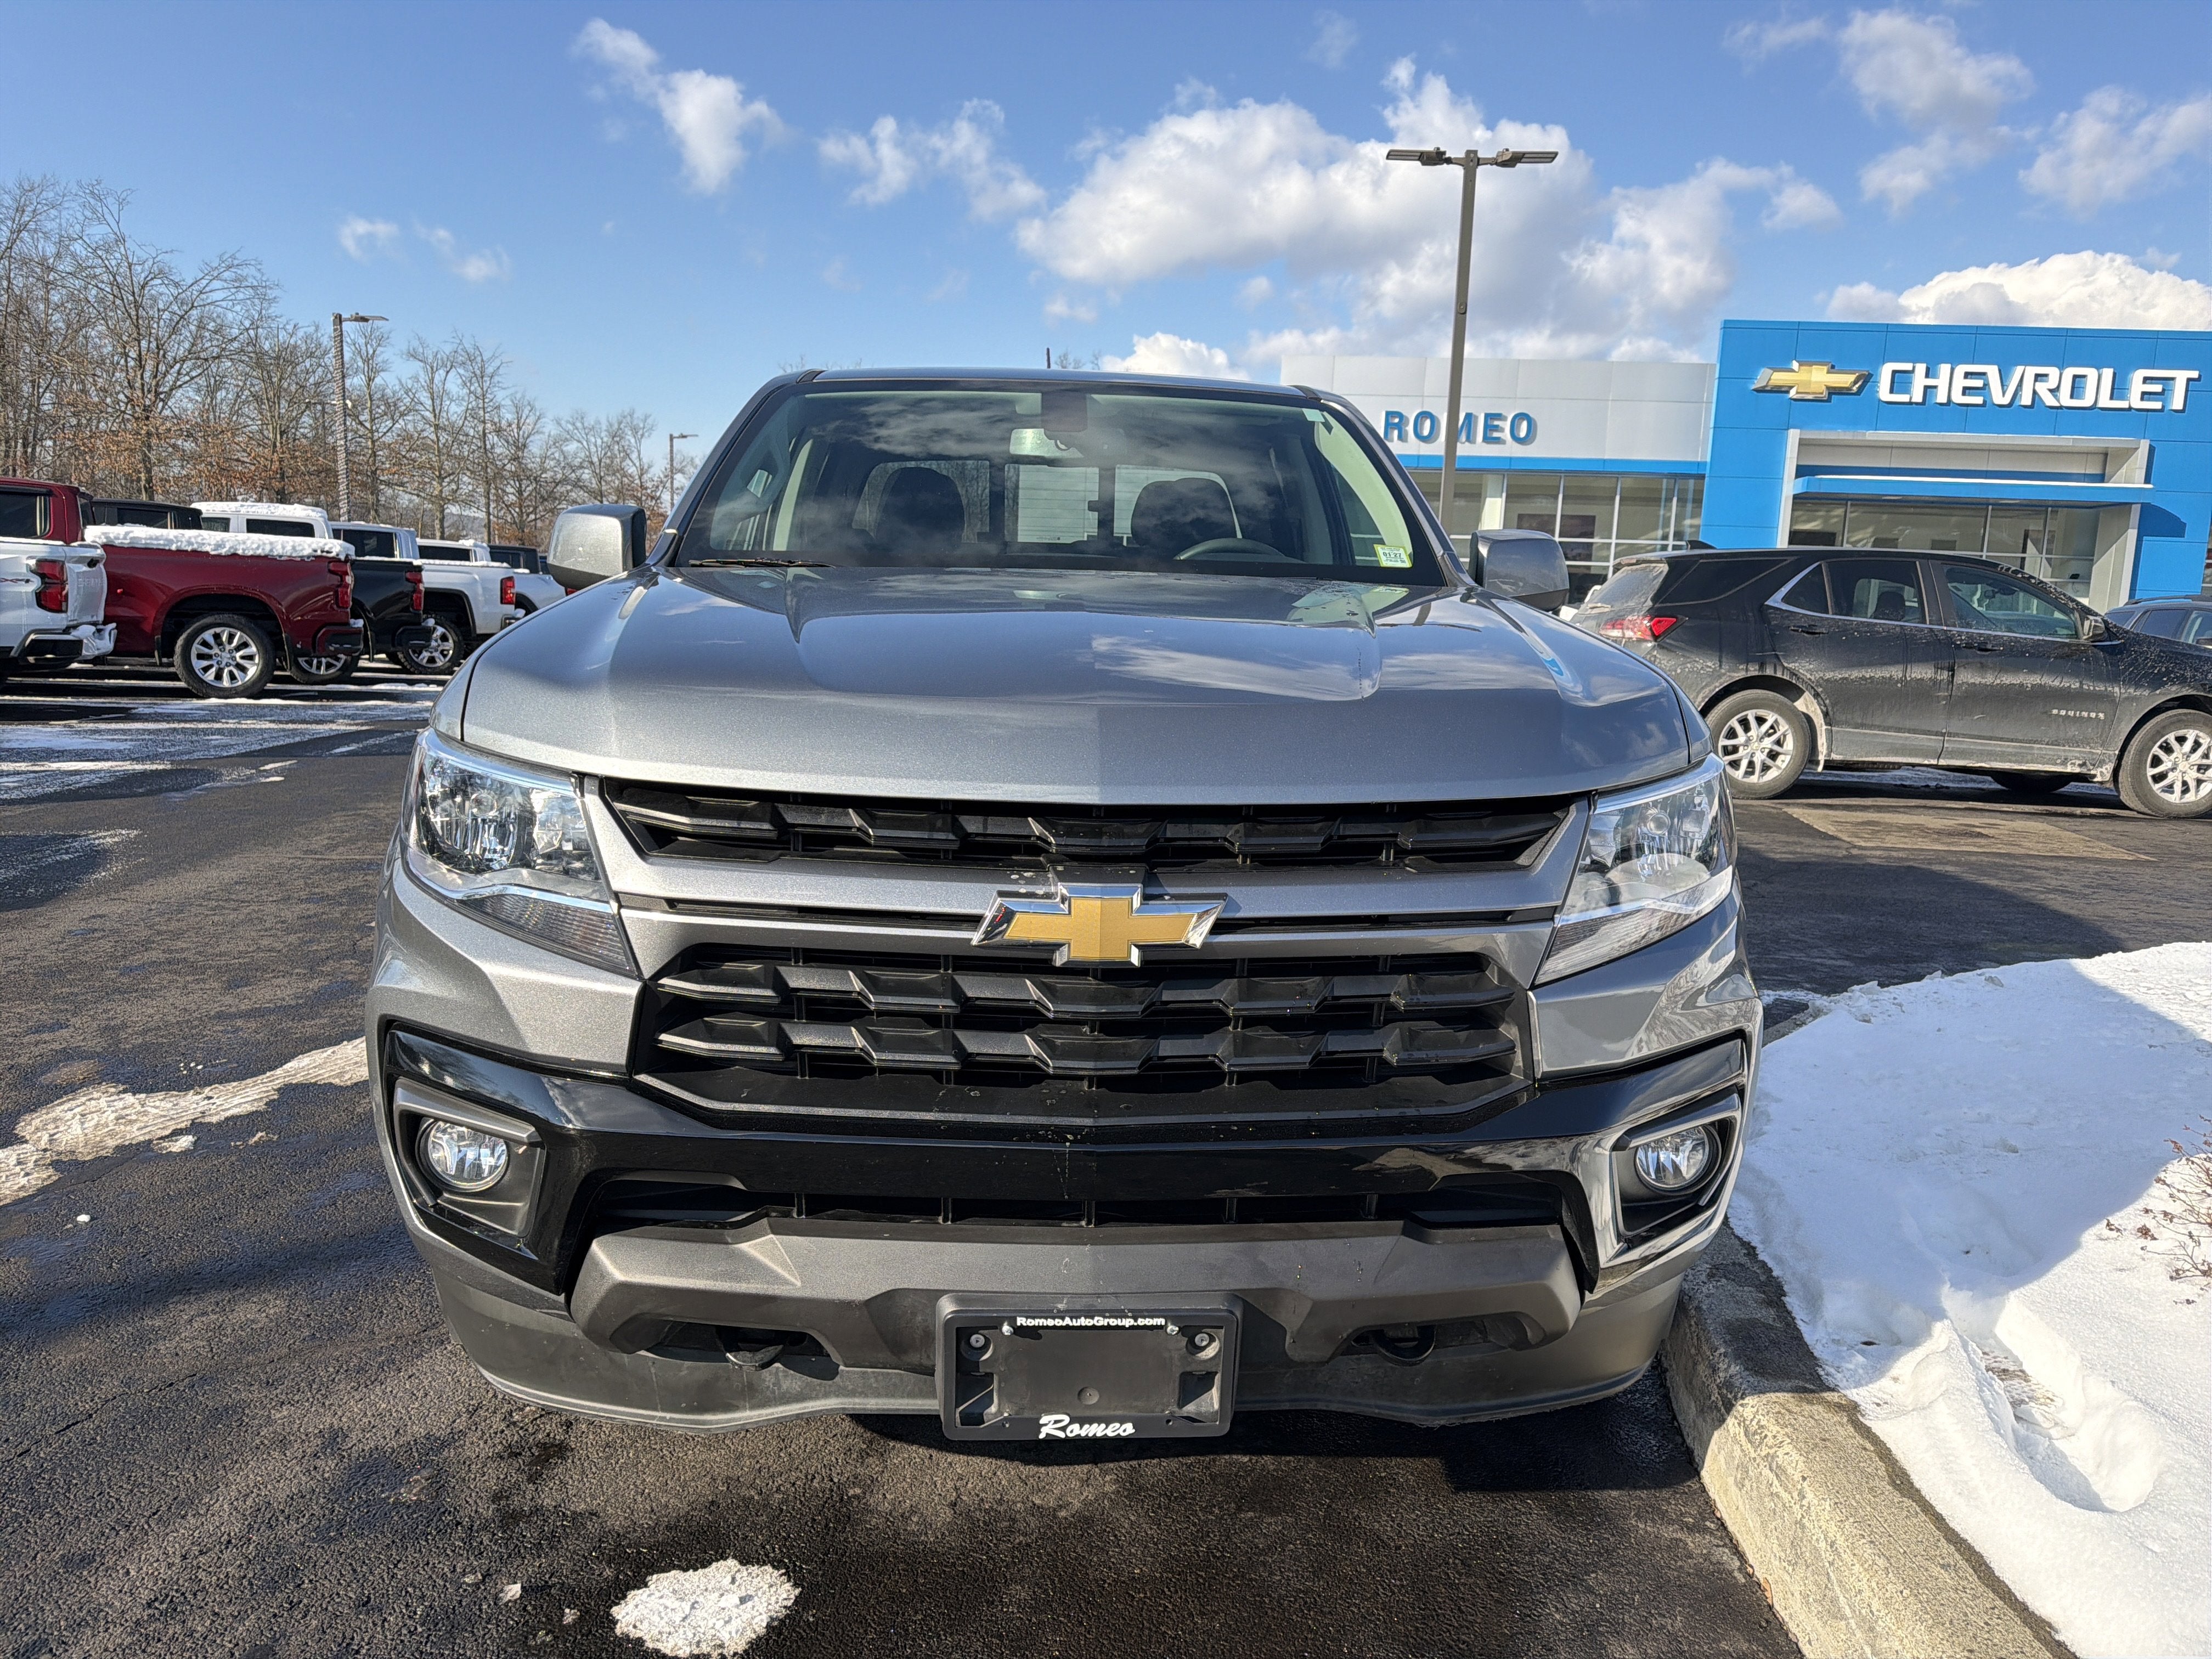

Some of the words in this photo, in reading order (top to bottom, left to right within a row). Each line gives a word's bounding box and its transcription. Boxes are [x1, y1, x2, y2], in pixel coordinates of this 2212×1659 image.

[1878, 363, 2199, 410] CHEVROLET
[1383, 410, 1534, 443] ROMEO
[1017, 1316, 1166, 1328] RomeoAutoGroup.com
[1039, 1414, 1136, 1439] Romeo
